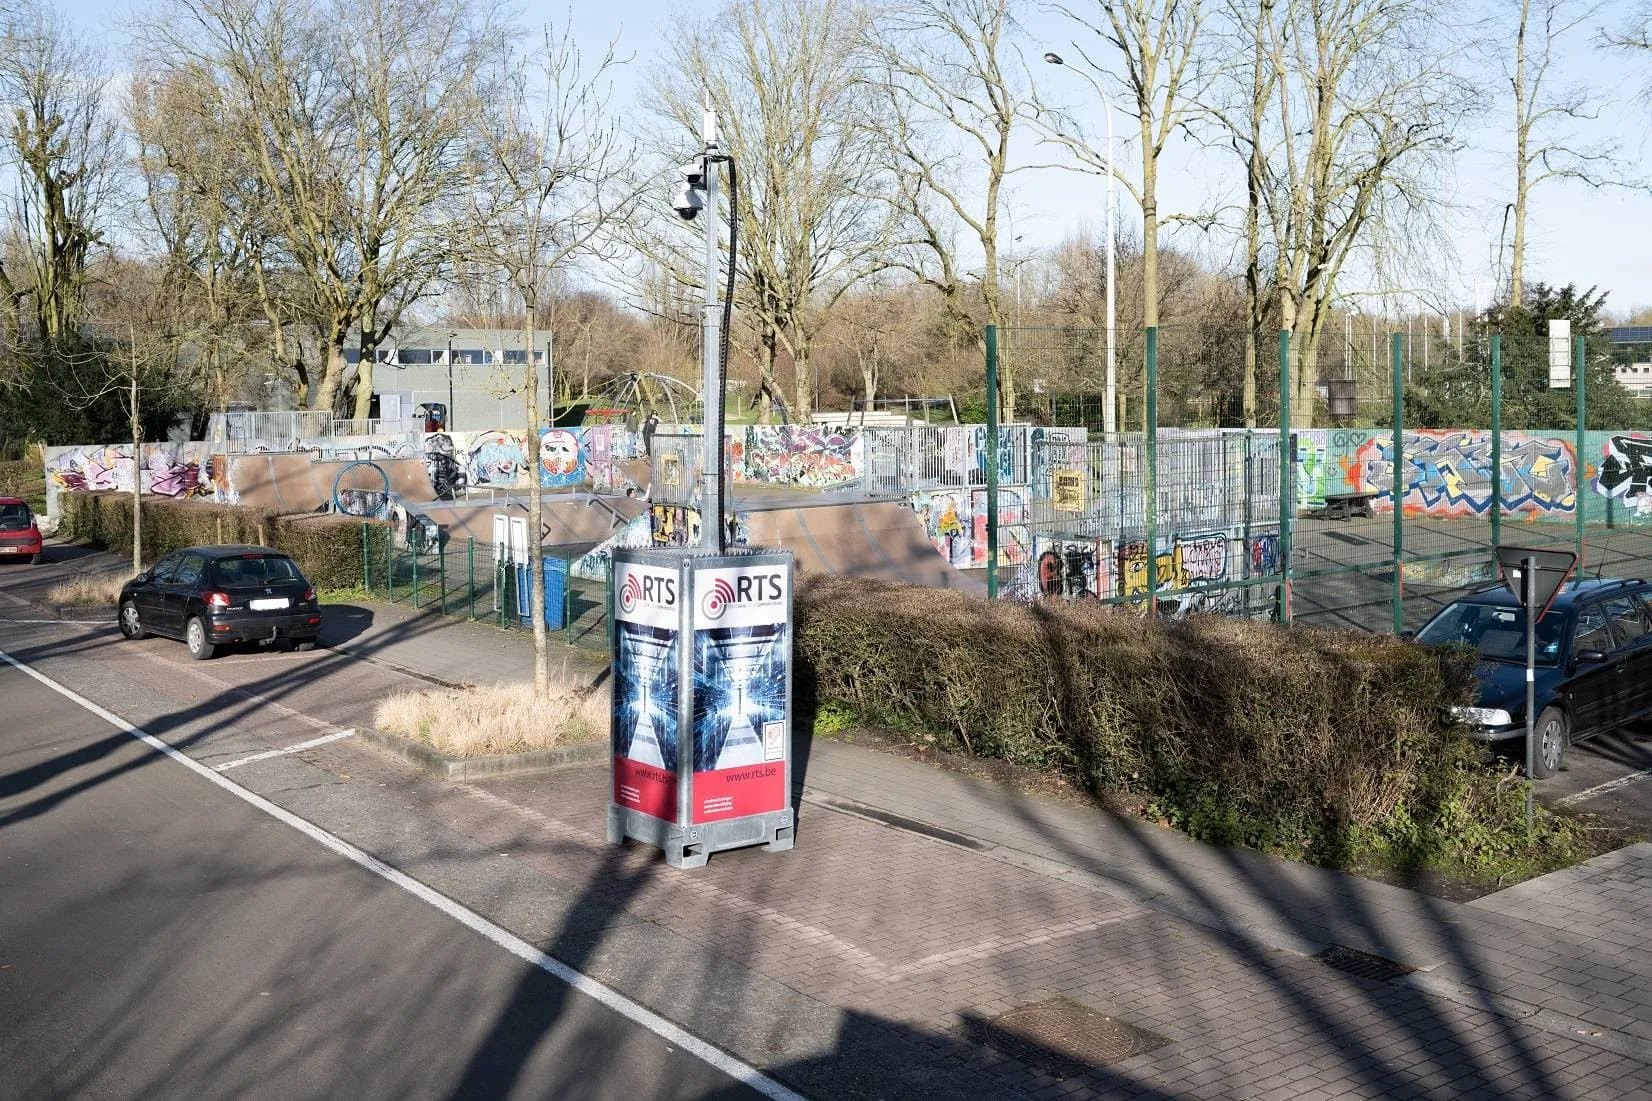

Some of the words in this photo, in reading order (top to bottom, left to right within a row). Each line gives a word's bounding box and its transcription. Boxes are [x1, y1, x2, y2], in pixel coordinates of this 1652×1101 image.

[643, 574, 676, 606] RTS
[737, 573, 783, 603] RTS
[726, 766, 777, 783] www.rts.be
